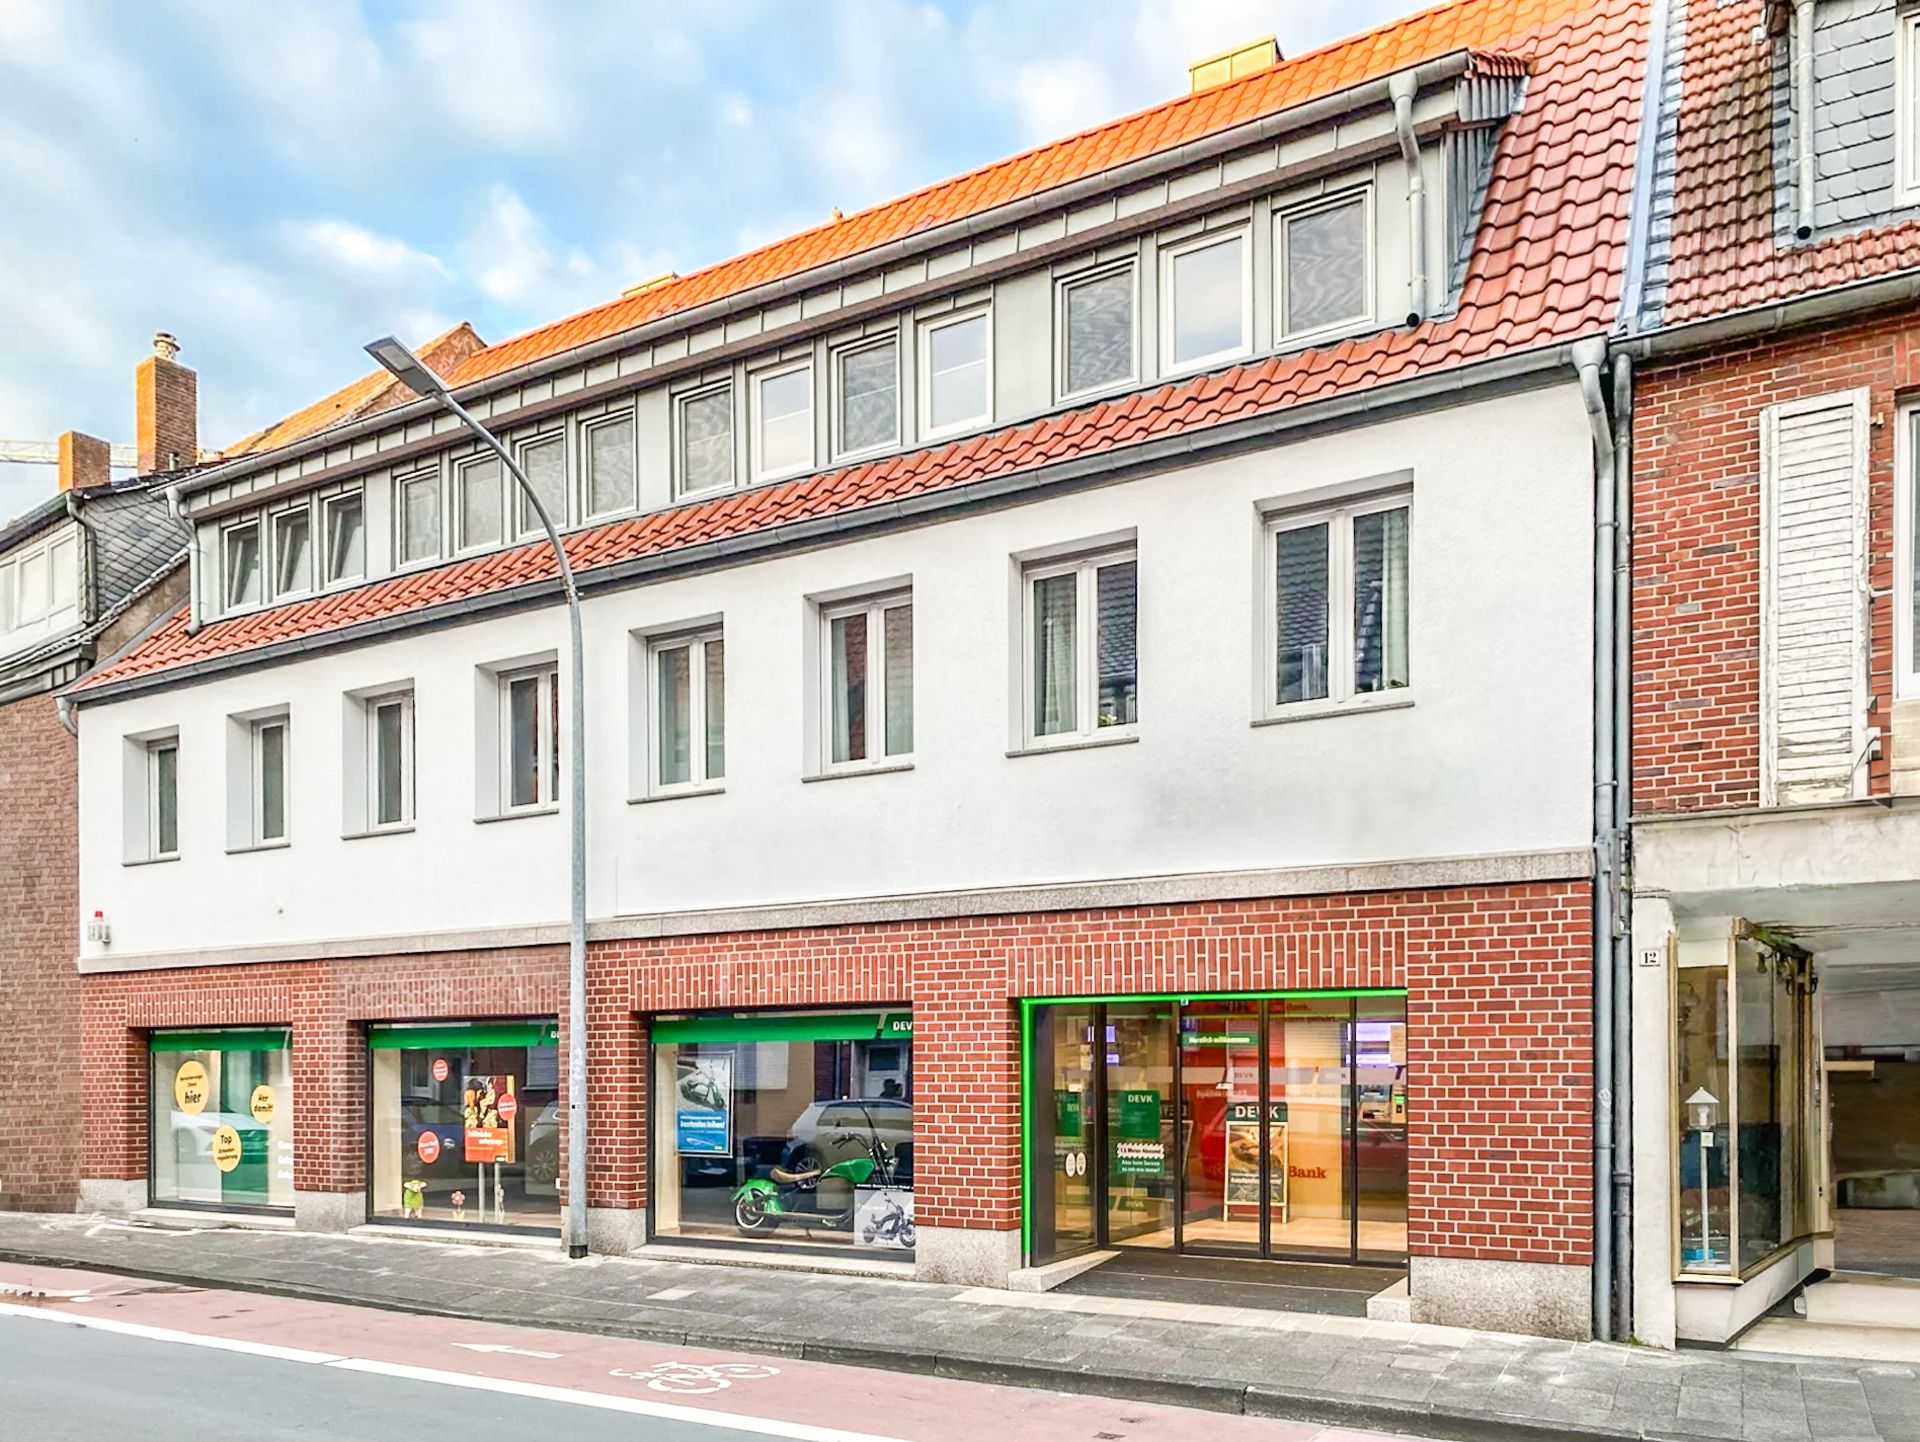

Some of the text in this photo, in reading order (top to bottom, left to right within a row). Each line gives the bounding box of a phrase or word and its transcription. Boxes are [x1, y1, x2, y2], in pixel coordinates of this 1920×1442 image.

[1644, 952, 1657, 964] 12
[184, 1090, 202, 1105] hier
[1127, 1095, 1153, 1103] DEVK
[1234, 1106, 1279, 1119] DEK
[219, 1134, 233, 1146] Top
[1288, 1165, 1327, 1179] Bank
